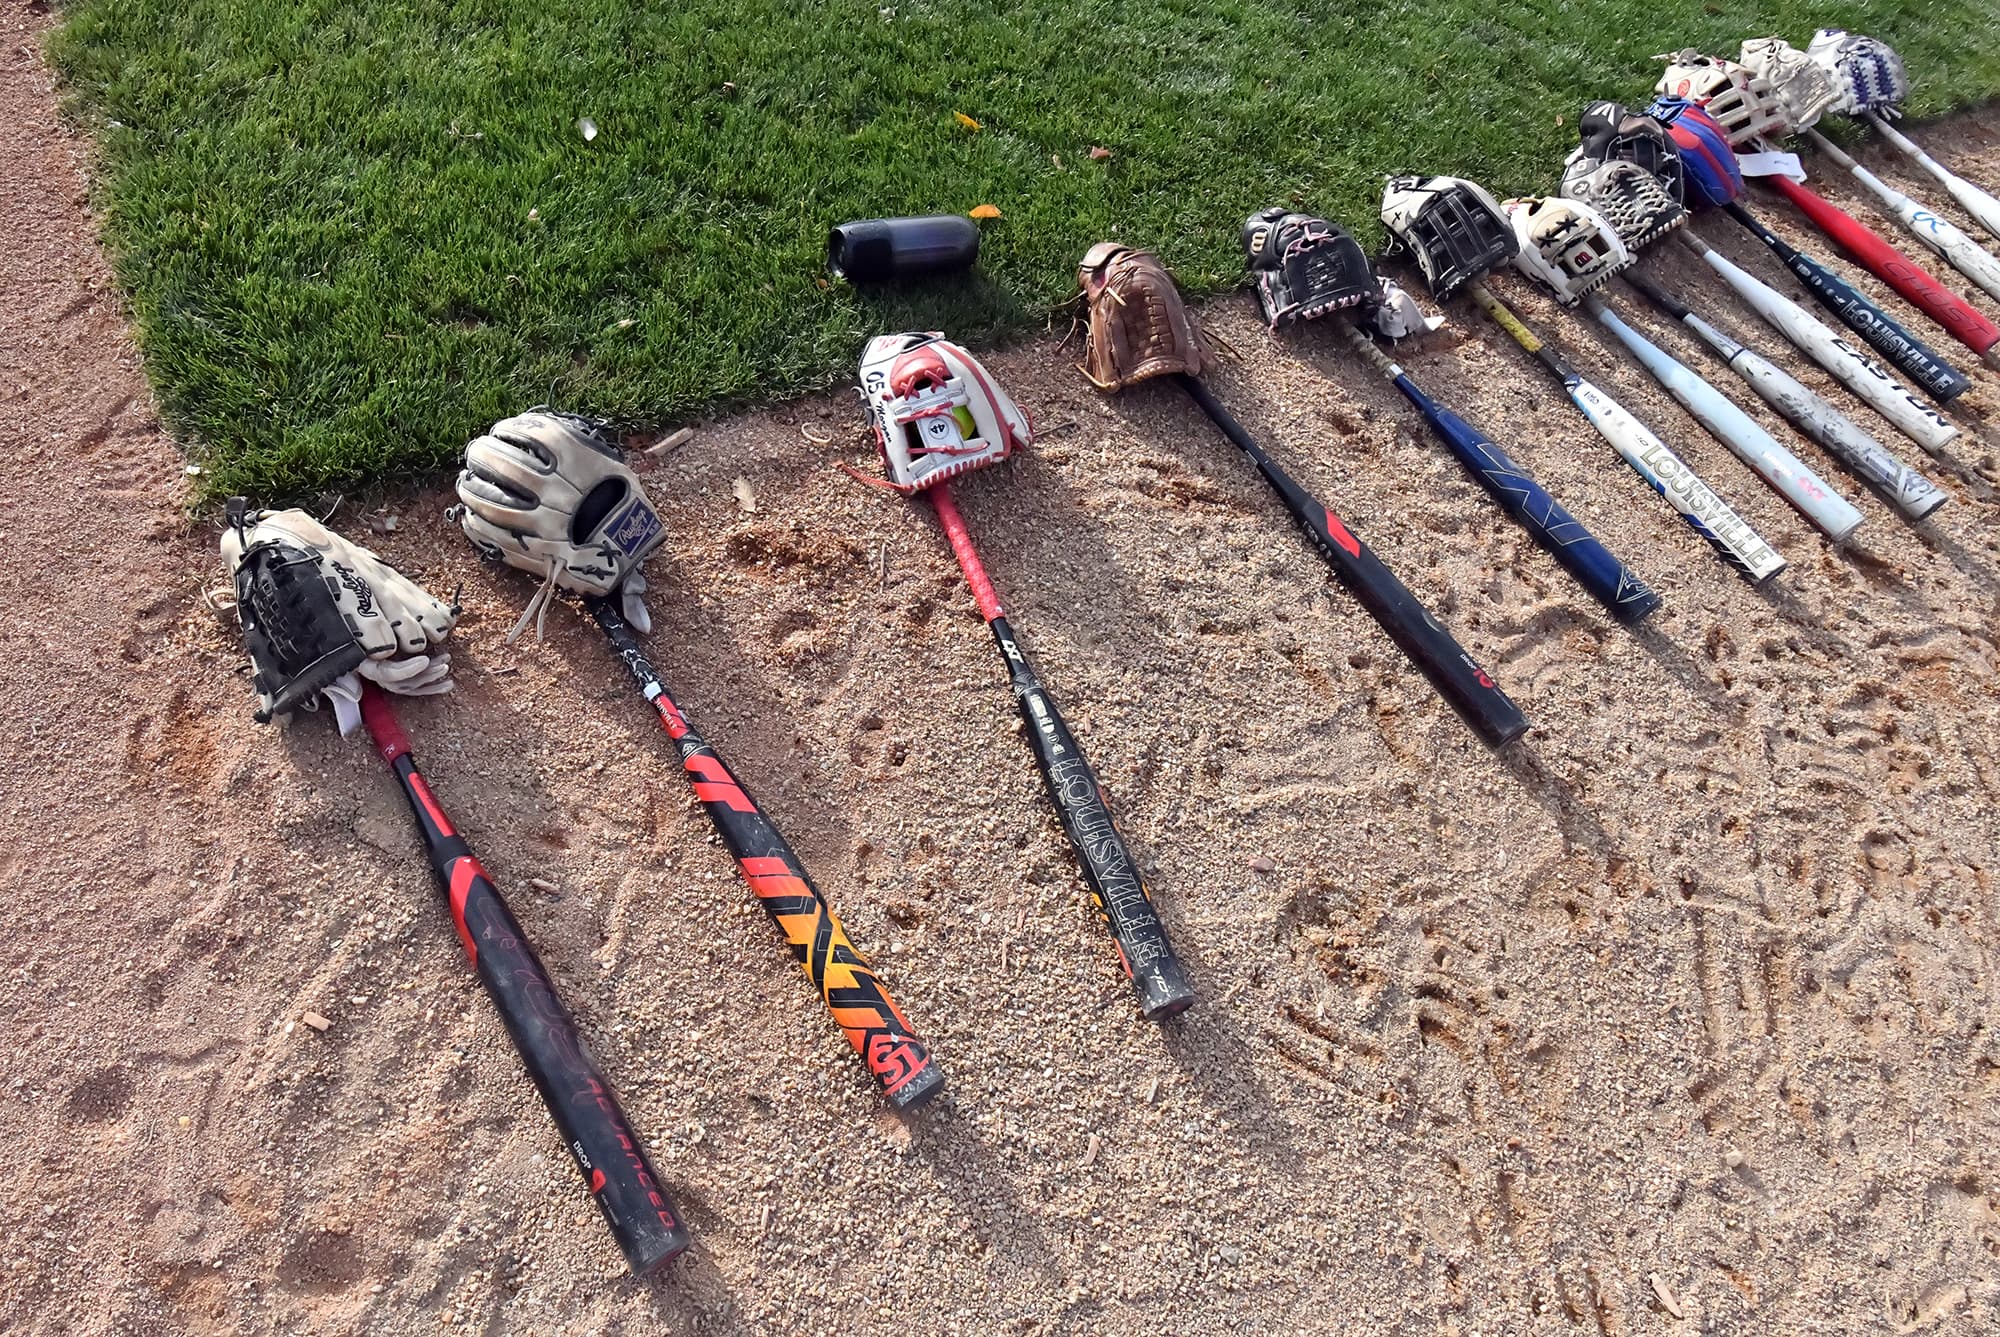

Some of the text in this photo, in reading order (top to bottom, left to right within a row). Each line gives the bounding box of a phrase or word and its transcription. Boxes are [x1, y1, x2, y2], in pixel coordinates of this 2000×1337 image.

[865, 371, 885, 395] 05
[1830, 338, 1951, 428] EASTON
[1841, 298, 1955, 395] LOUISVILLE
[1639, 444, 1775, 569] LOUISVILLE
[330, 560, 379, 618] Rawlings
[1052, 757, 1168, 968] LOUISVILLE
[573, 1140, 593, 1170] DROP
[586, 1077, 675, 1228] ADVANCED
